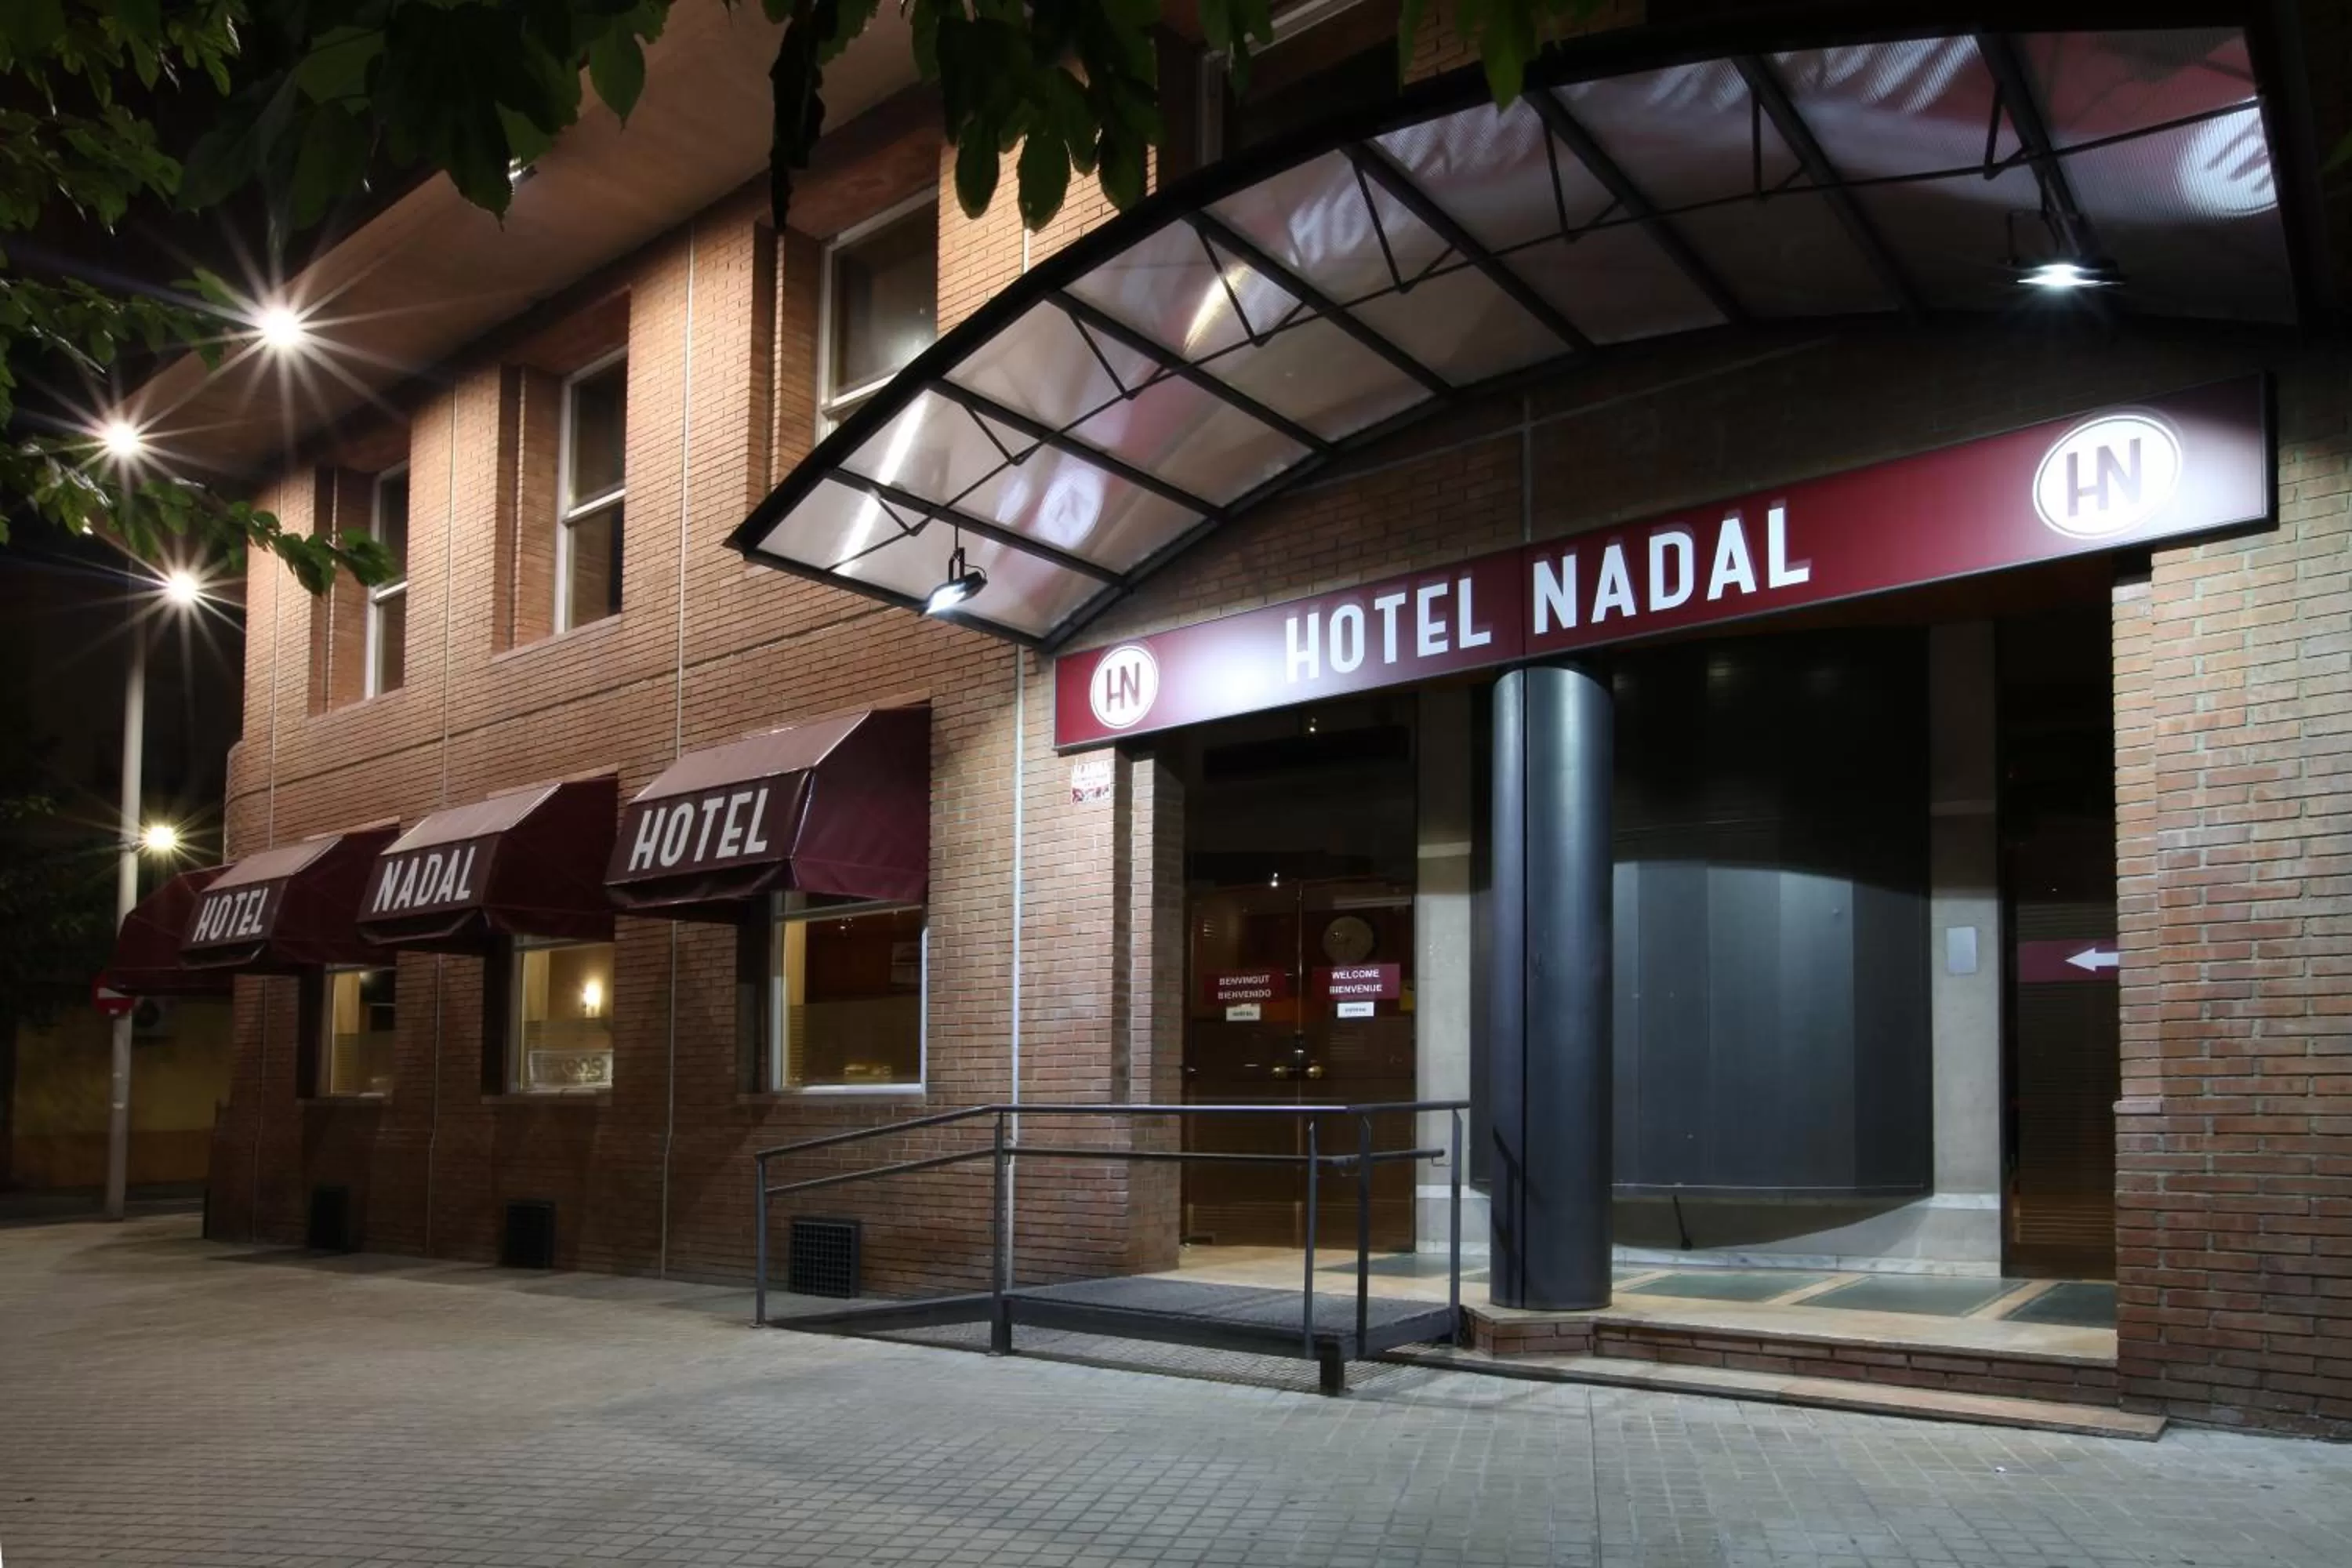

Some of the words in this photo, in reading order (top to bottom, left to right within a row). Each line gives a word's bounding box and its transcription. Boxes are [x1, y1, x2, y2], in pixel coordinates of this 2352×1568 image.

[1285, 577, 1491, 684] HOTEL
[1533, 507, 1809, 635] NADAL
[628, 788, 769, 872] HOTEL
[372, 846, 477, 913] NADAL
[192, 887, 269, 942] HOTEL
[1218, 989, 1272, 1000] BIENVENIDO
[1330, 984, 1383, 995] BIENVENUE
[1331, 968, 1380, 979] WELCOME
